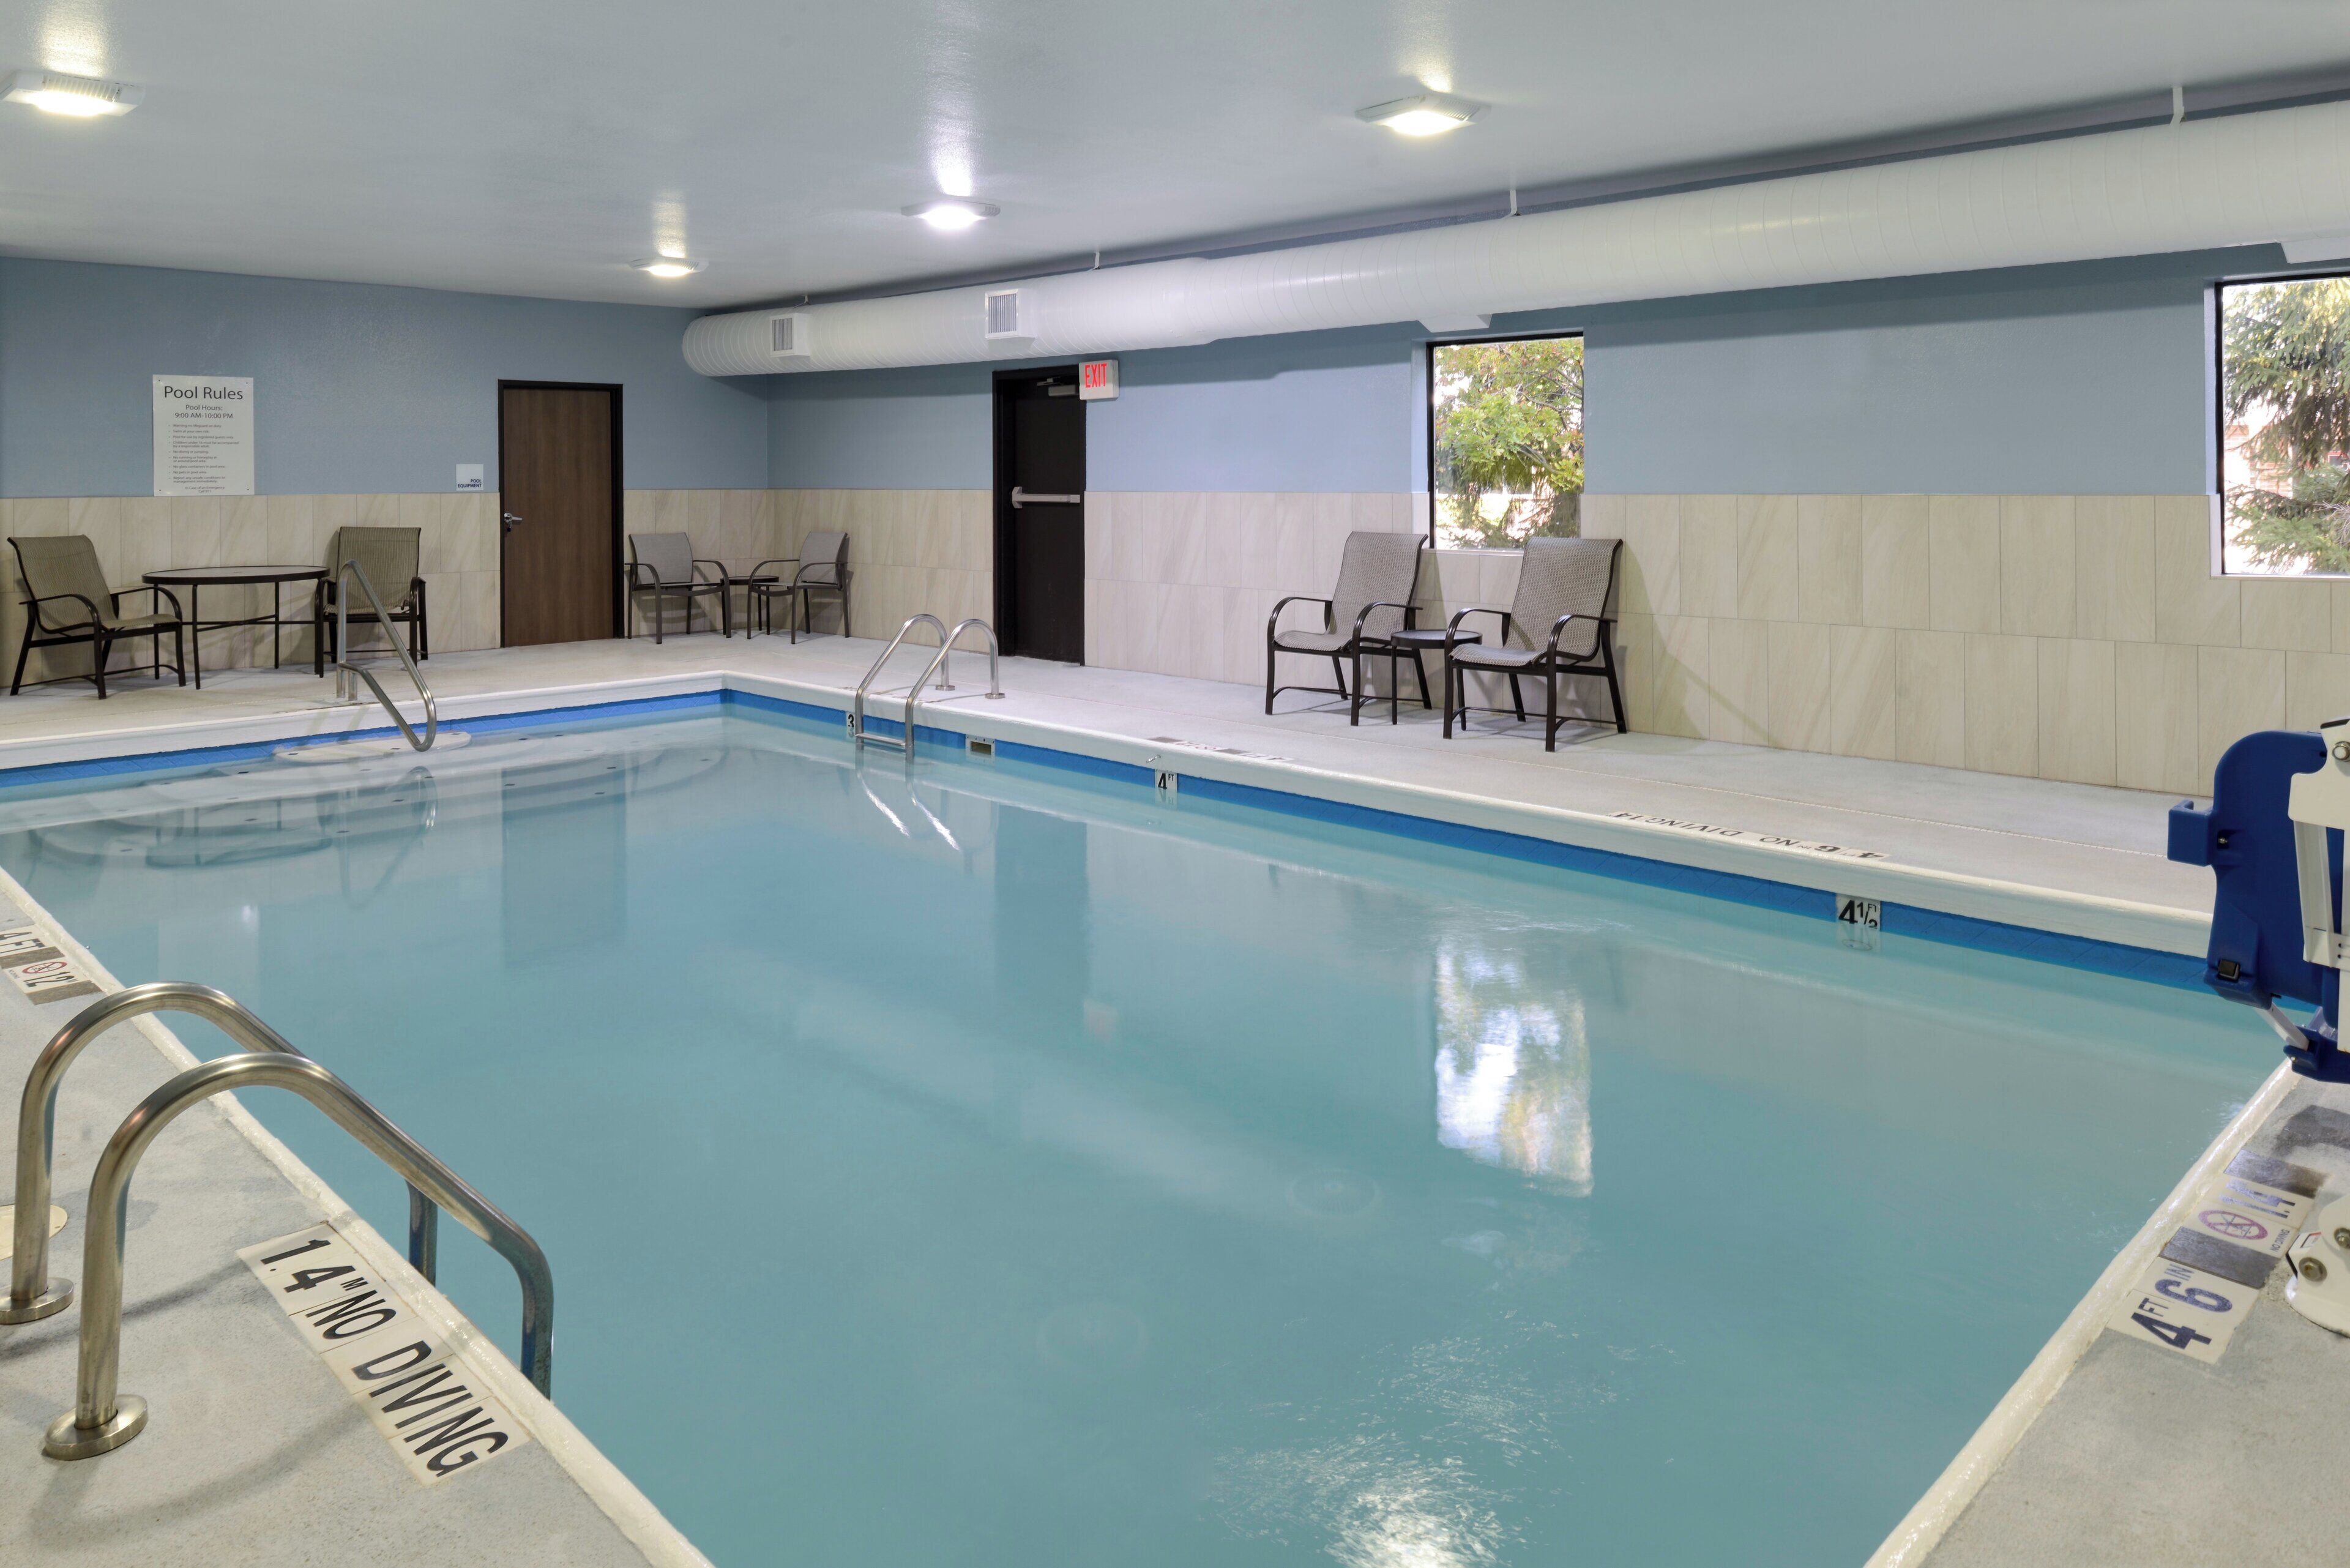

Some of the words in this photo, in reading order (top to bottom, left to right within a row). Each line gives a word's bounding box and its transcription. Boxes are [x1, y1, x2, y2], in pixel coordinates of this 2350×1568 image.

[1084, 363, 1107, 388] EXIT
[164, 386, 198, 398] Pool
[203, 387, 244, 400] Rules
[1158, 772, 1168, 790] 4
[1168, 773, 1175, 782] FT
[1644, 817, 1744, 837] DIVING
[1759, 837, 1800, 846] NO
[2163, 1263, 2195, 1282] IN
[2154, 1278, 2233, 1313] 6
[2138, 1297, 2169, 1318] FT
[2130, 1312, 2212, 1350] 4
[305, 1289, 397, 1340] NO
[351, 1340, 509, 1478] DIVING
